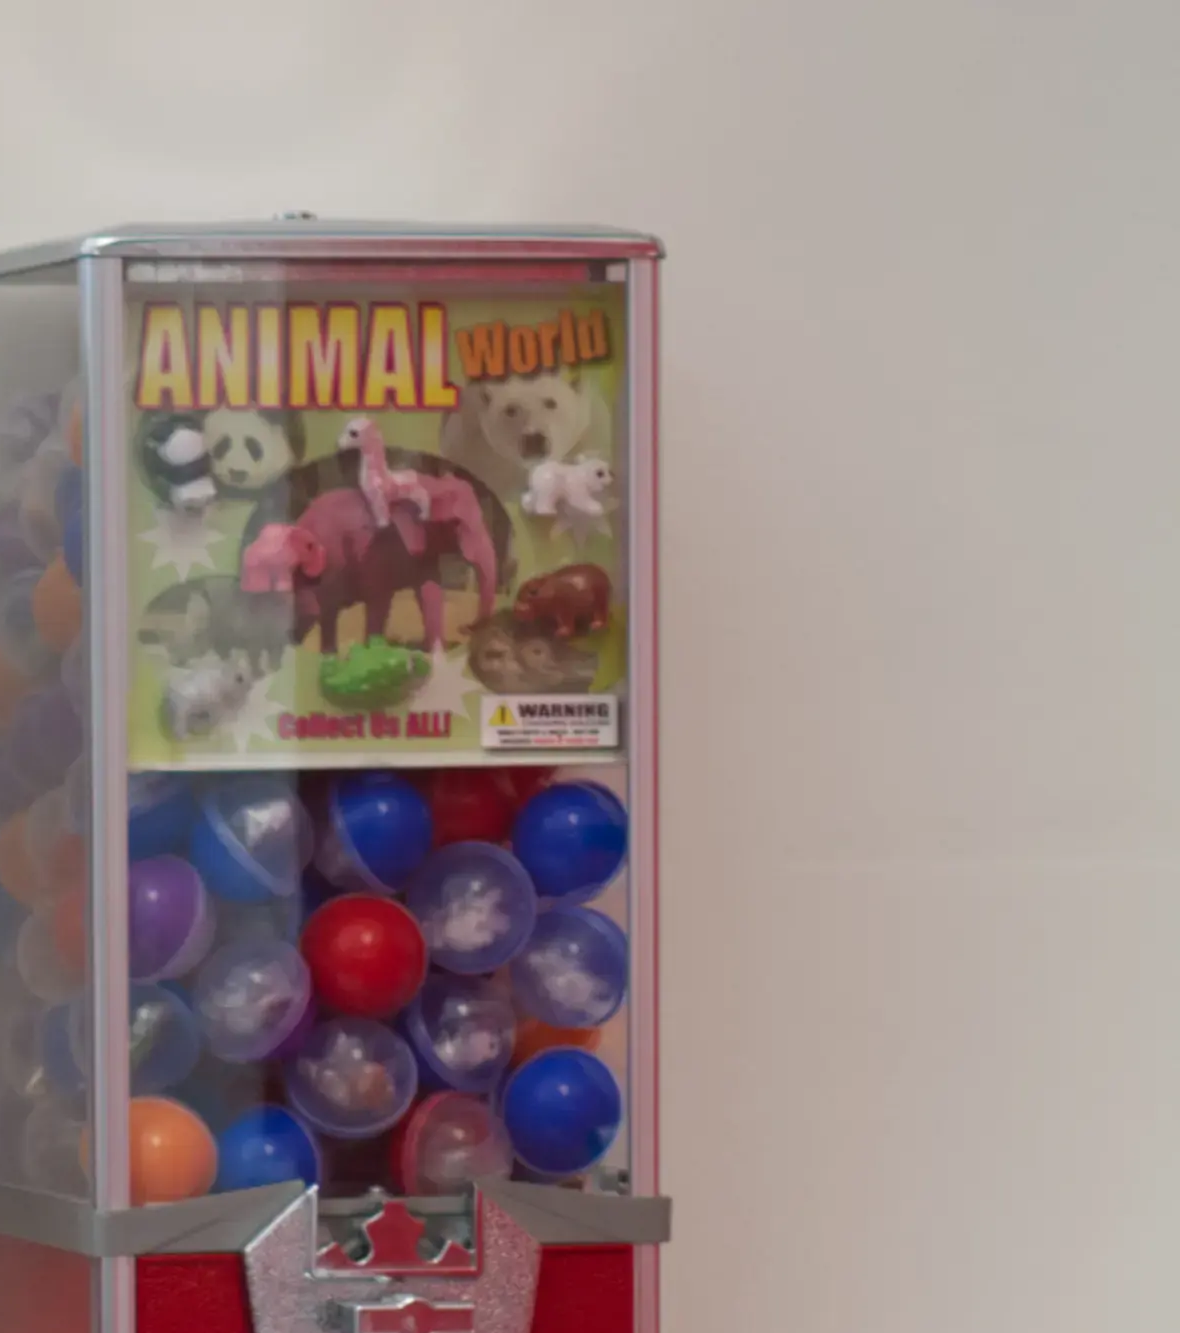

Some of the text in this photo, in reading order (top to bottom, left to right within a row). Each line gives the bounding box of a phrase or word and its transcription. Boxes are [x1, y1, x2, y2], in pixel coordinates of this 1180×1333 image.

[136, 302, 609, 410] ANIMAL World
[517, 702, 610, 718] WARNING
[406, 711, 451, 738] ALL!
